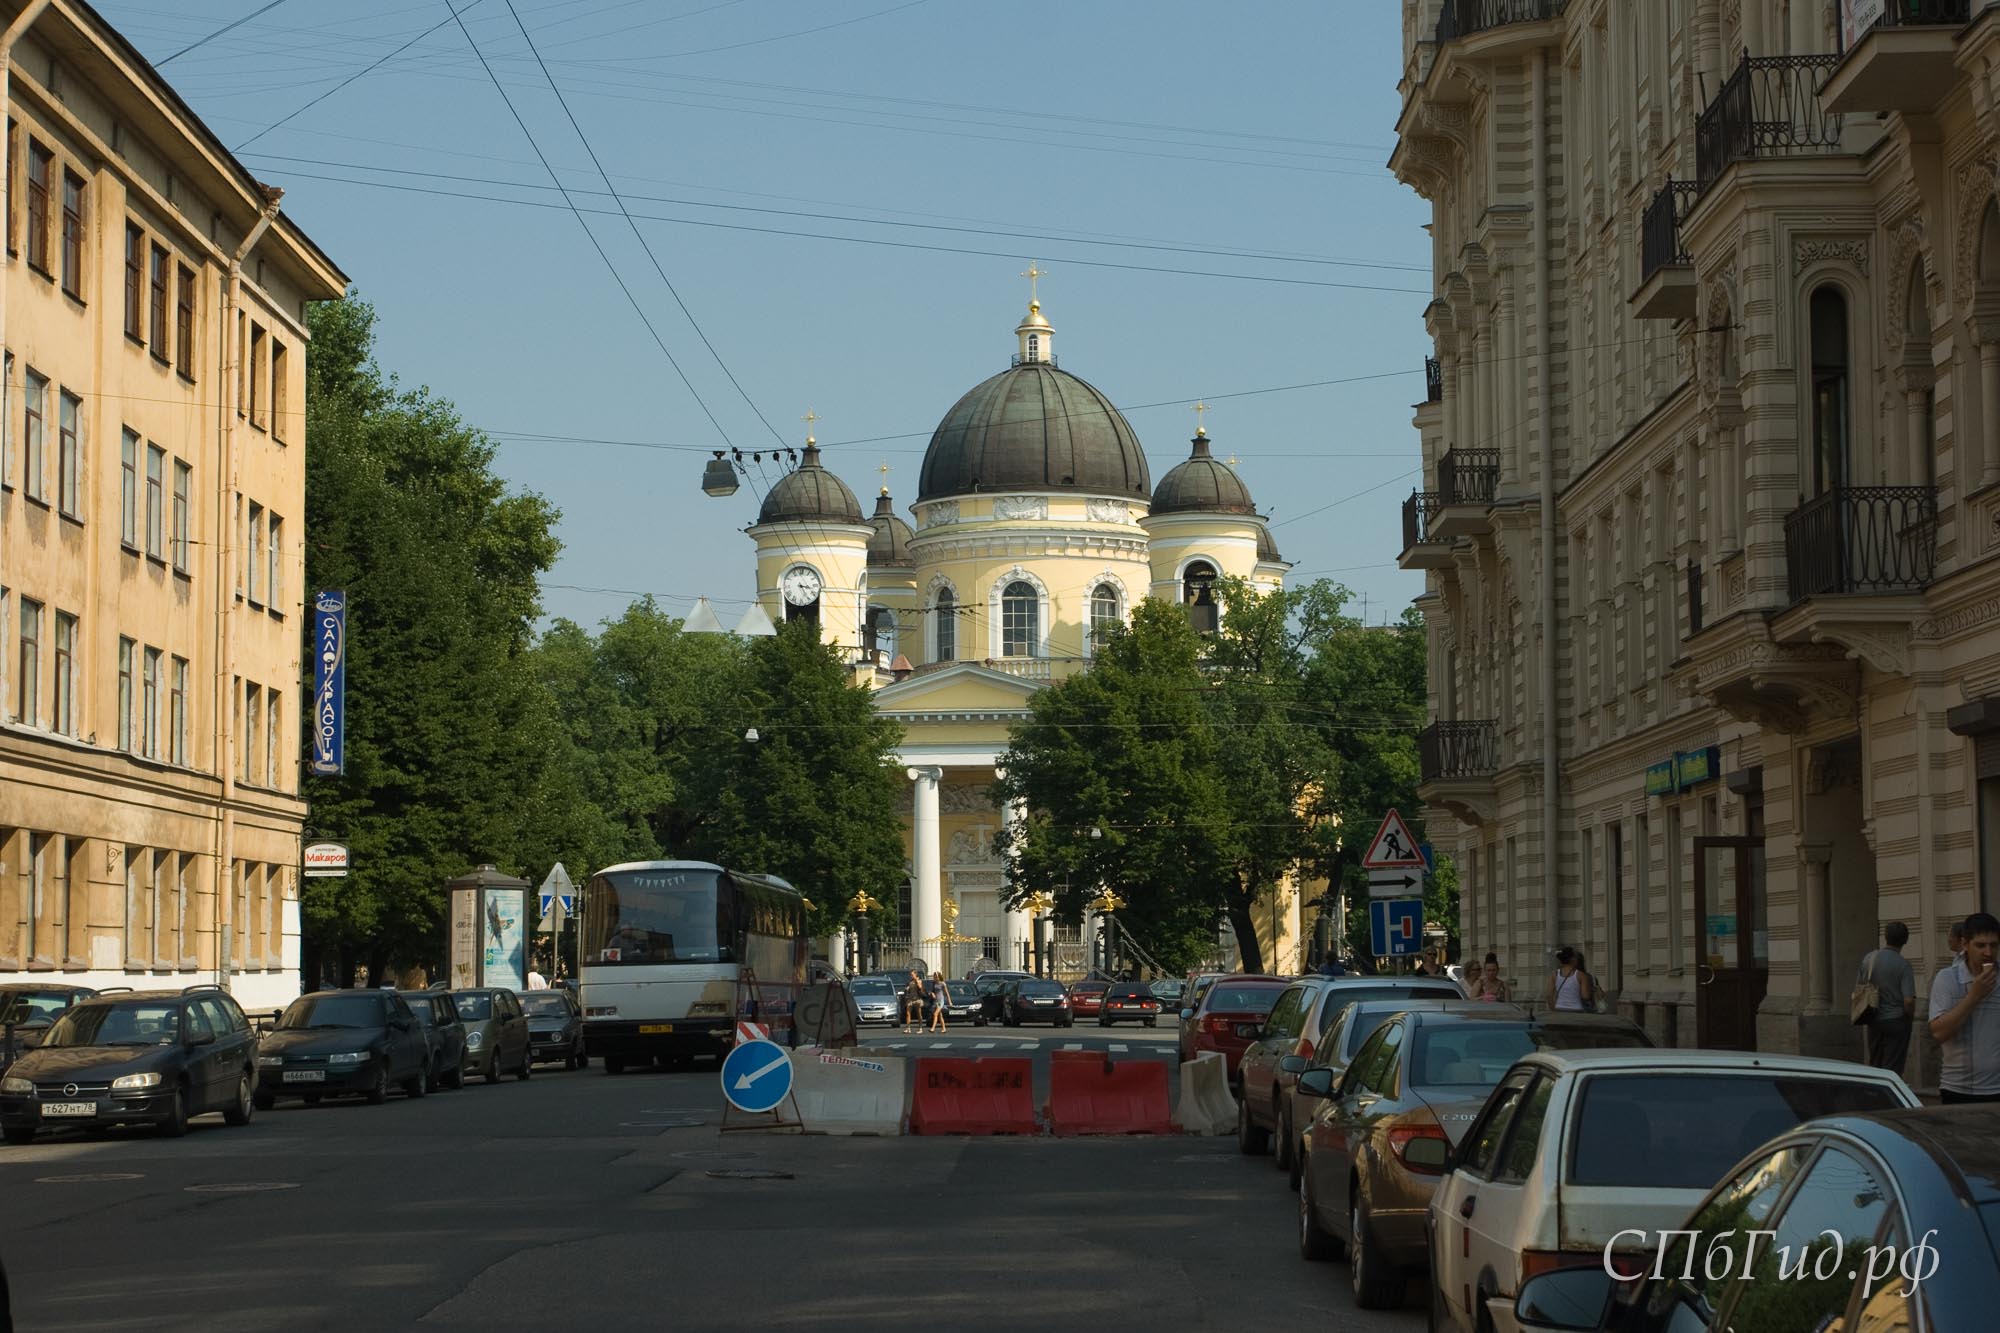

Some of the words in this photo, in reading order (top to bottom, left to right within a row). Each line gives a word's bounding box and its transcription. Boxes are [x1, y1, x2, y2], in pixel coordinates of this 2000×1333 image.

[322, 617, 336, 675] САЛОН
[322, 680, 335, 762] КРАСОТЫ
[306, 853, 346, 865] Макаров
